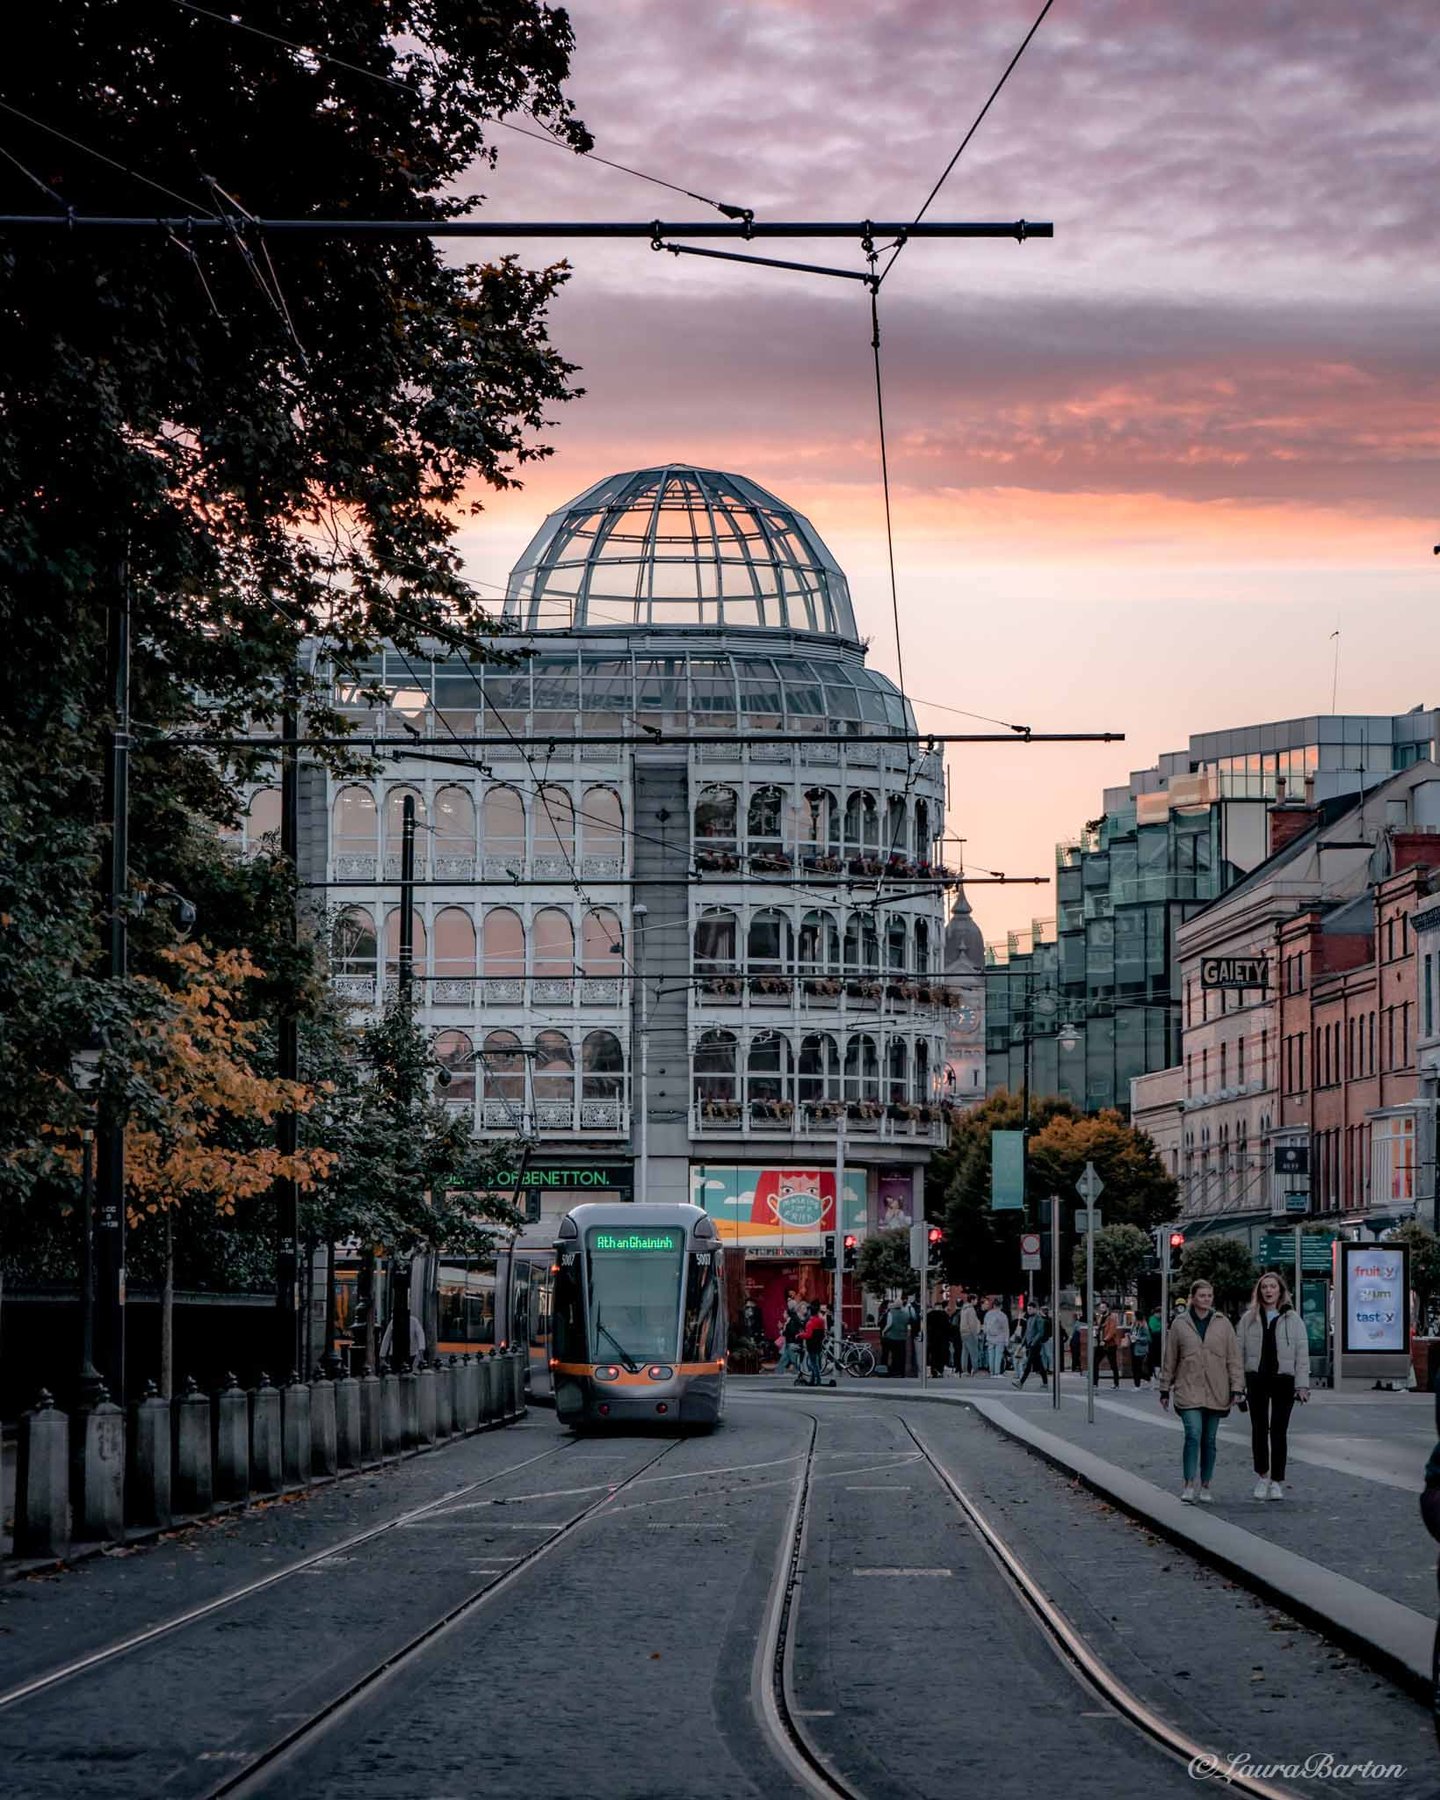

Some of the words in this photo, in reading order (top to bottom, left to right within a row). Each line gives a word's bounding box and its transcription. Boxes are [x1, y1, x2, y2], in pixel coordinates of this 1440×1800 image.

[1203, 960, 1266, 983] GAIETY
[497, 1171, 519, 1185] OF
[561, 1254, 575, 1266] 5007
